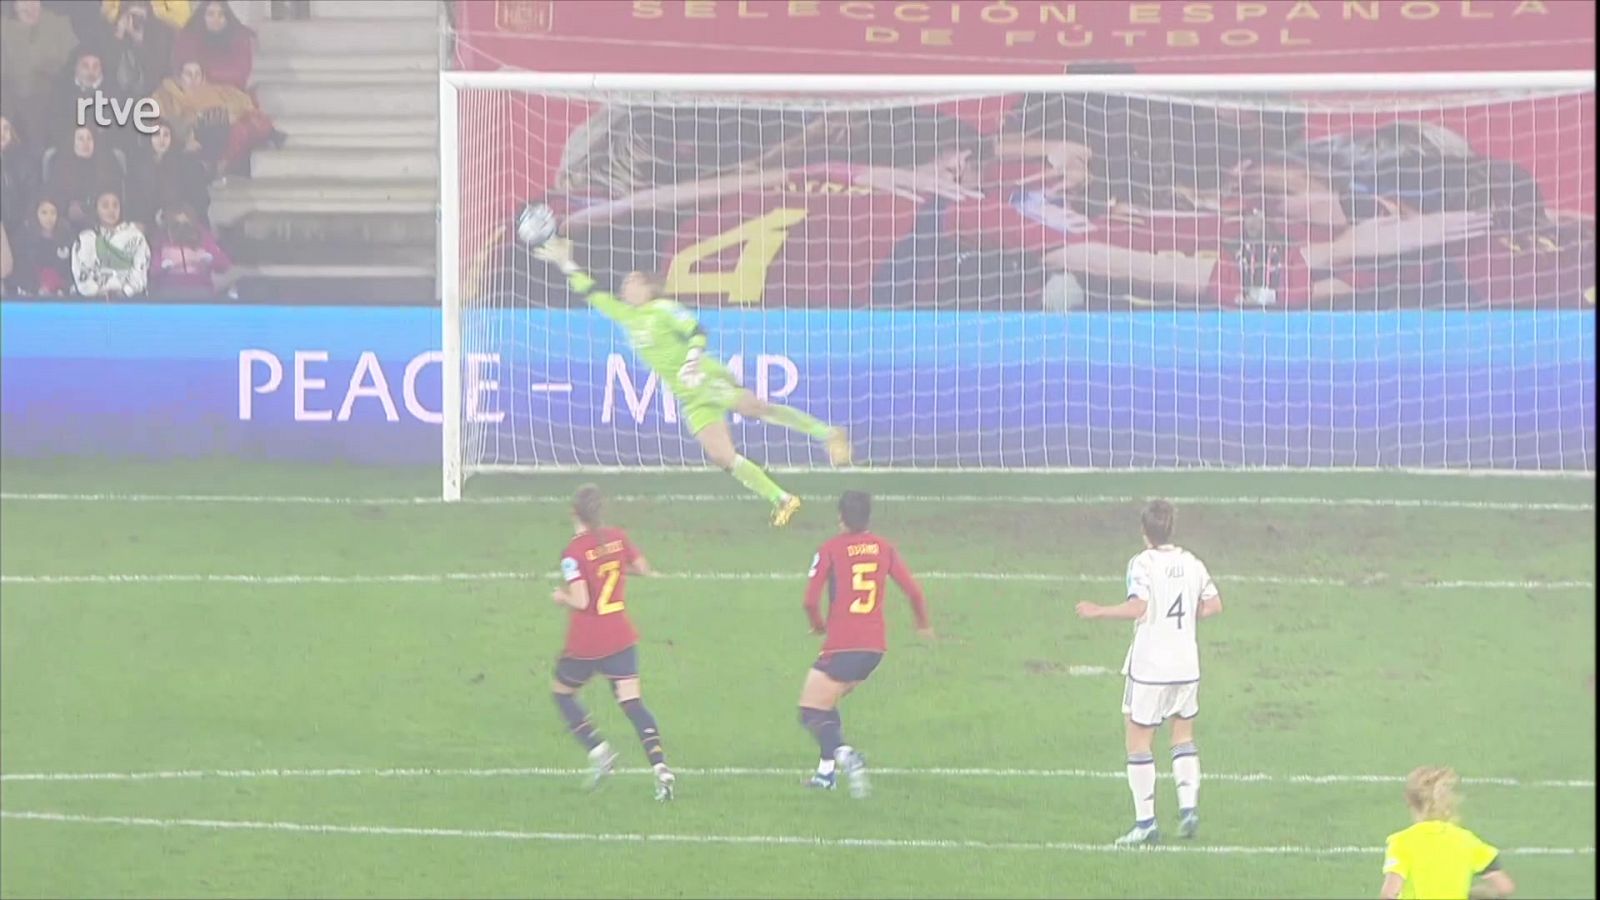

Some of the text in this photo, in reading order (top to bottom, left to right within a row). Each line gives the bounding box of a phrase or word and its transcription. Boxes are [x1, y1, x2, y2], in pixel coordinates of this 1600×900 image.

[632, 1, 1077, 24] SELECCIÓN
[865, 24, 1312, 47] DE FÚTBOL
[663, 208, 808, 304] 4
[238, 348, 505, 424] PEACE
[597, 561, 624, 615] 2
[849, 563, 878, 614] 5
[1166, 593, 1186, 630] 4
